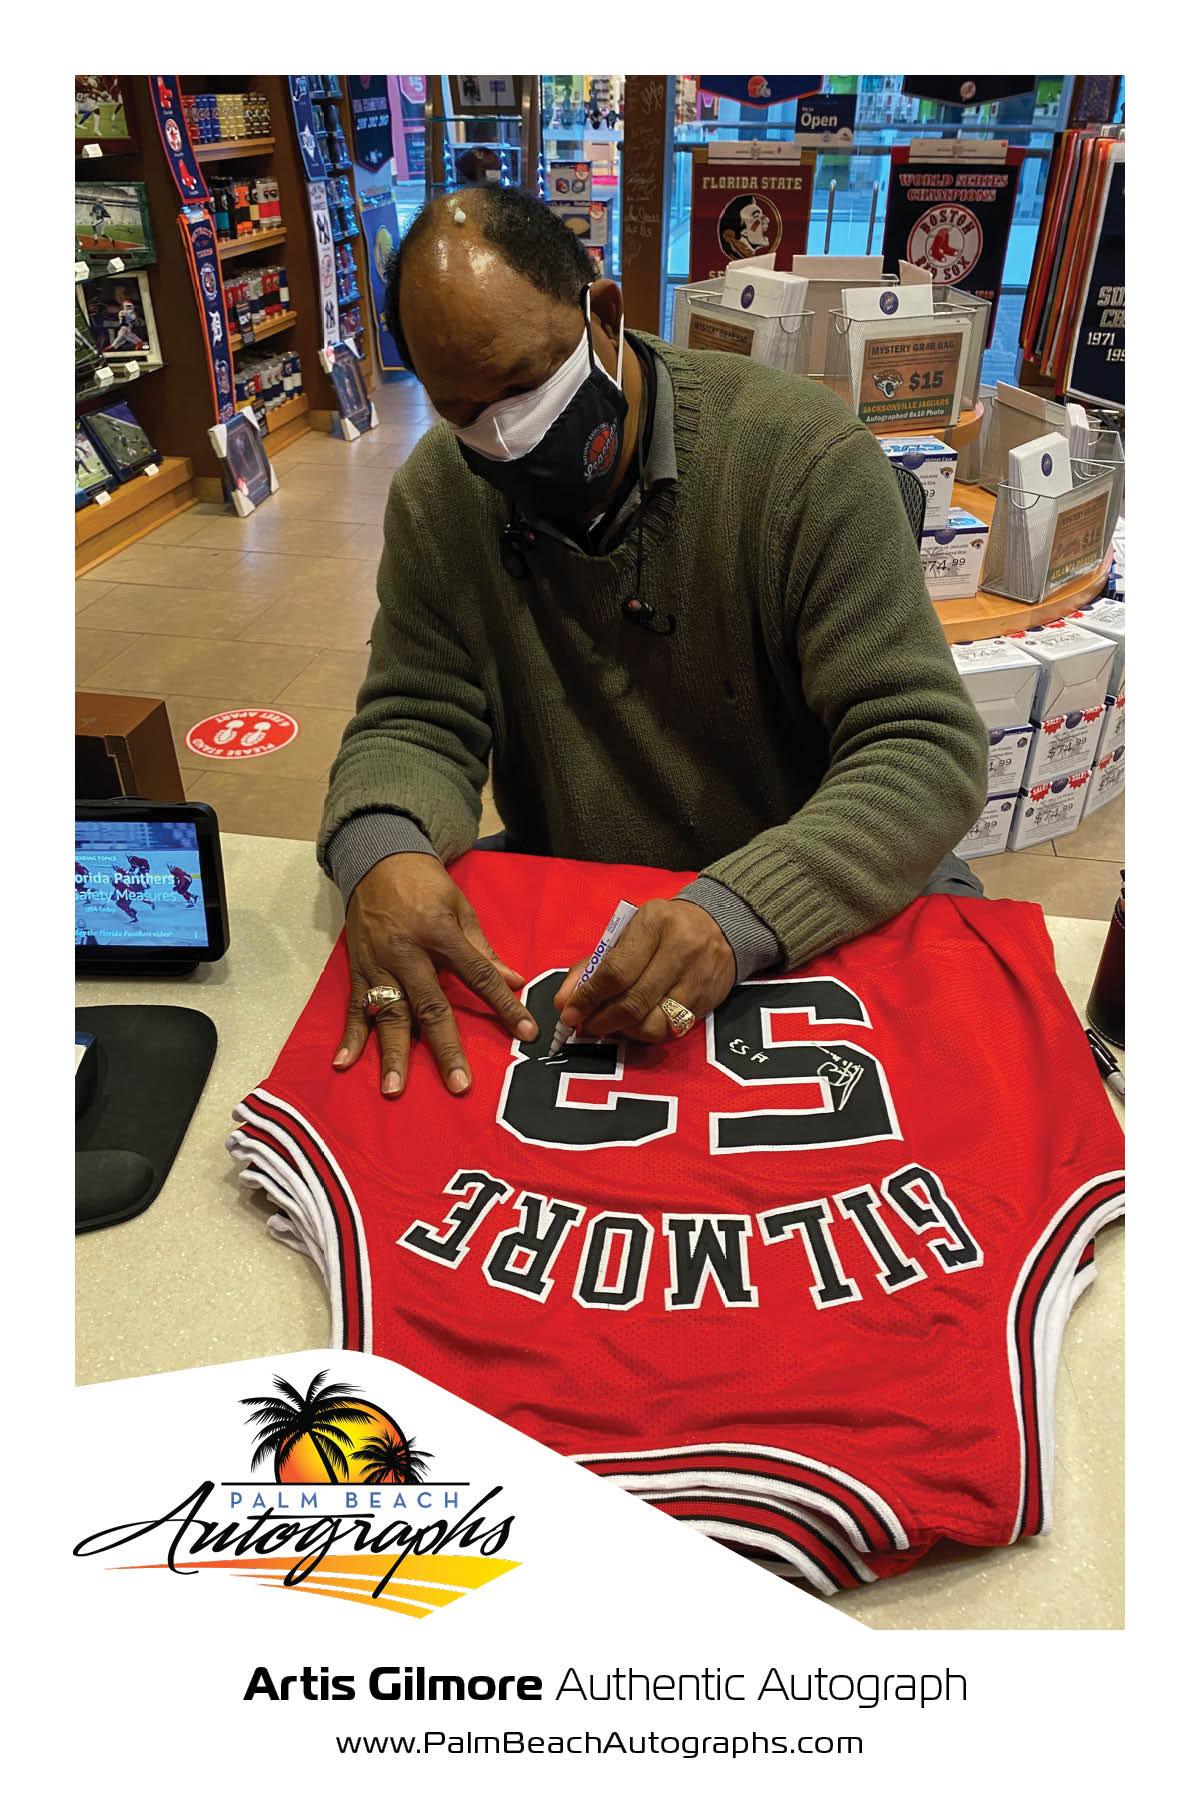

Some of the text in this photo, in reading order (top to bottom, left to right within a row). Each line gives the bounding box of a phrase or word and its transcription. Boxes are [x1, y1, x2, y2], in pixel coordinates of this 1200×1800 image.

[801, 112, 838, 128] Open
[702, 176, 803, 190] FLORIDA STATE
[899, 174, 1008, 187] WORLD SERIES
[906, 188, 996, 201] CHAMPIONS
[919, 208, 976, 236] BOSTON
[944, 256, 972, 281] SOX
[1087, 332, 1115, 346] 1971
[871, 339, 956, 356] MYSTERY GRAB BAG
[908, 370, 944, 391] $15
[863, 398, 949, 414] JACKSONVILLE JAGUARS
[865, 412, 908, 424] Autographed
[926, 407, 945, 417] Photo
[214, 711, 258, 724] APART
[191, 737, 275, 757] PLEASE STAND
[114, 872, 175, 886] Panthers
[116, 889, 177, 902] Measures
[396, 1162, 985, 1311] GILMORE
